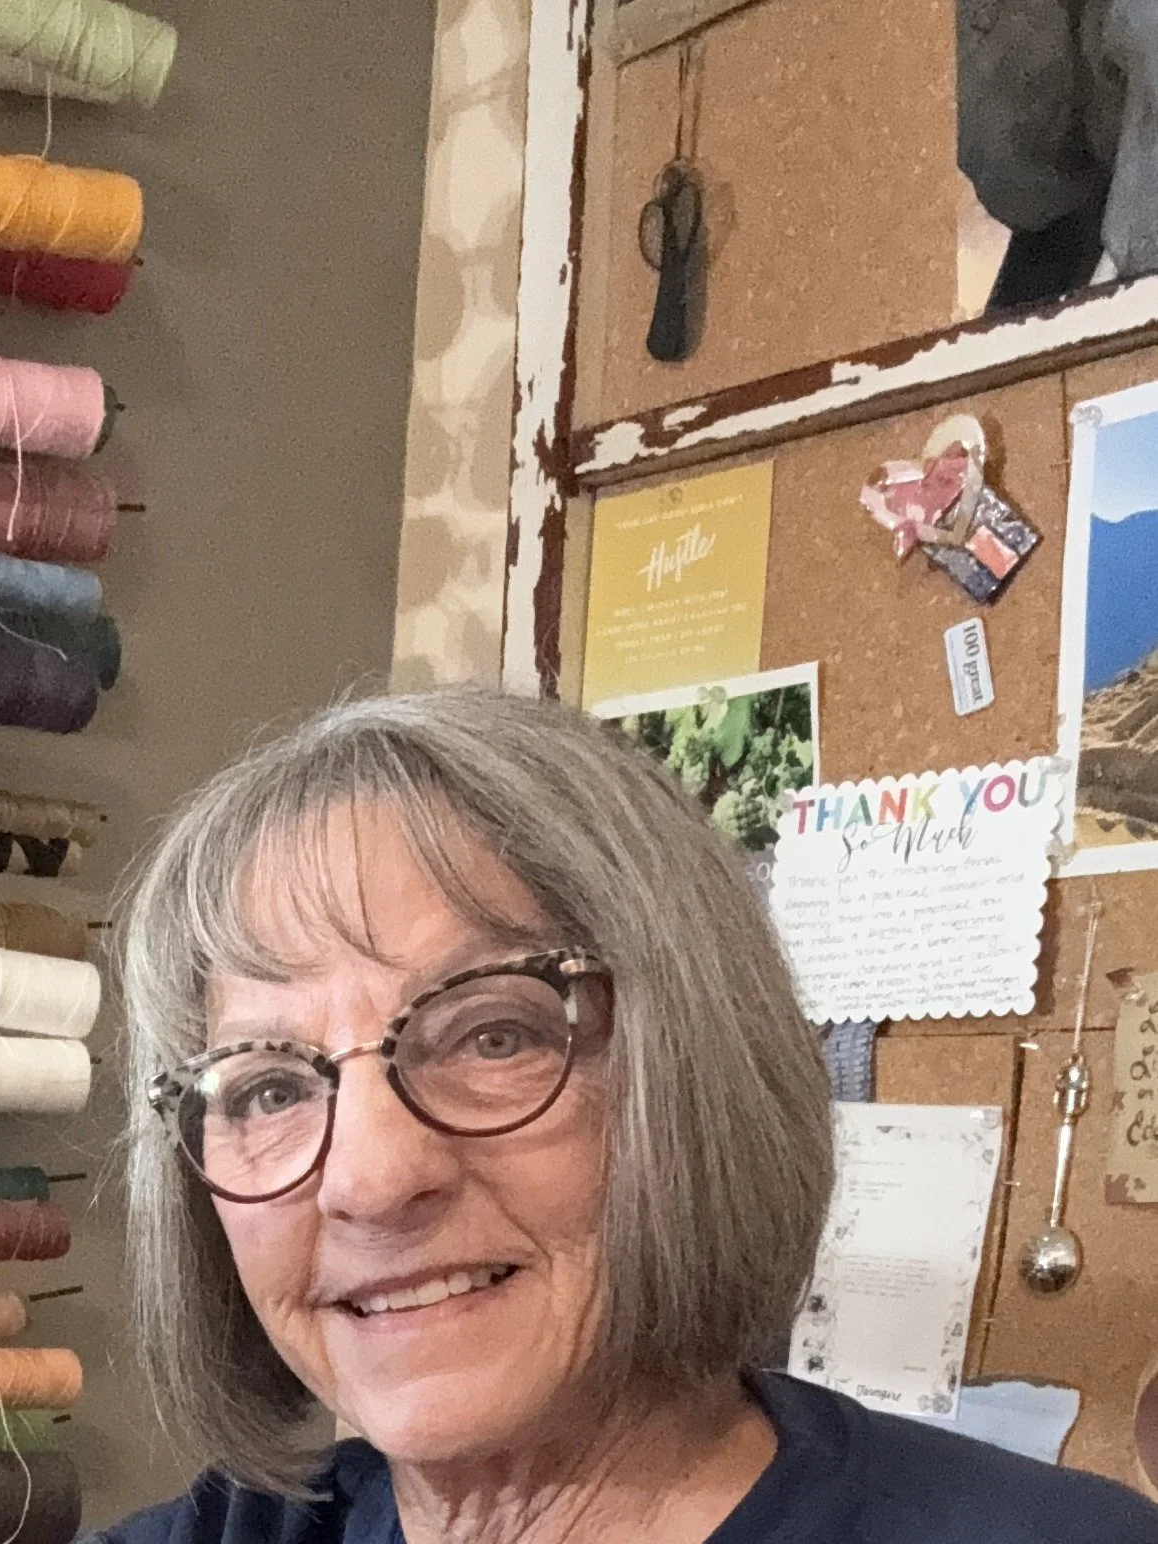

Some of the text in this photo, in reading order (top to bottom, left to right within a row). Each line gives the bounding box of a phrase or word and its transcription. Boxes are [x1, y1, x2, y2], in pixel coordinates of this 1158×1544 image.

[963, 623, 980, 657] 100
[793, 769, 1046, 835] THANK YOU
[838, 802, 978, 873] So Much
